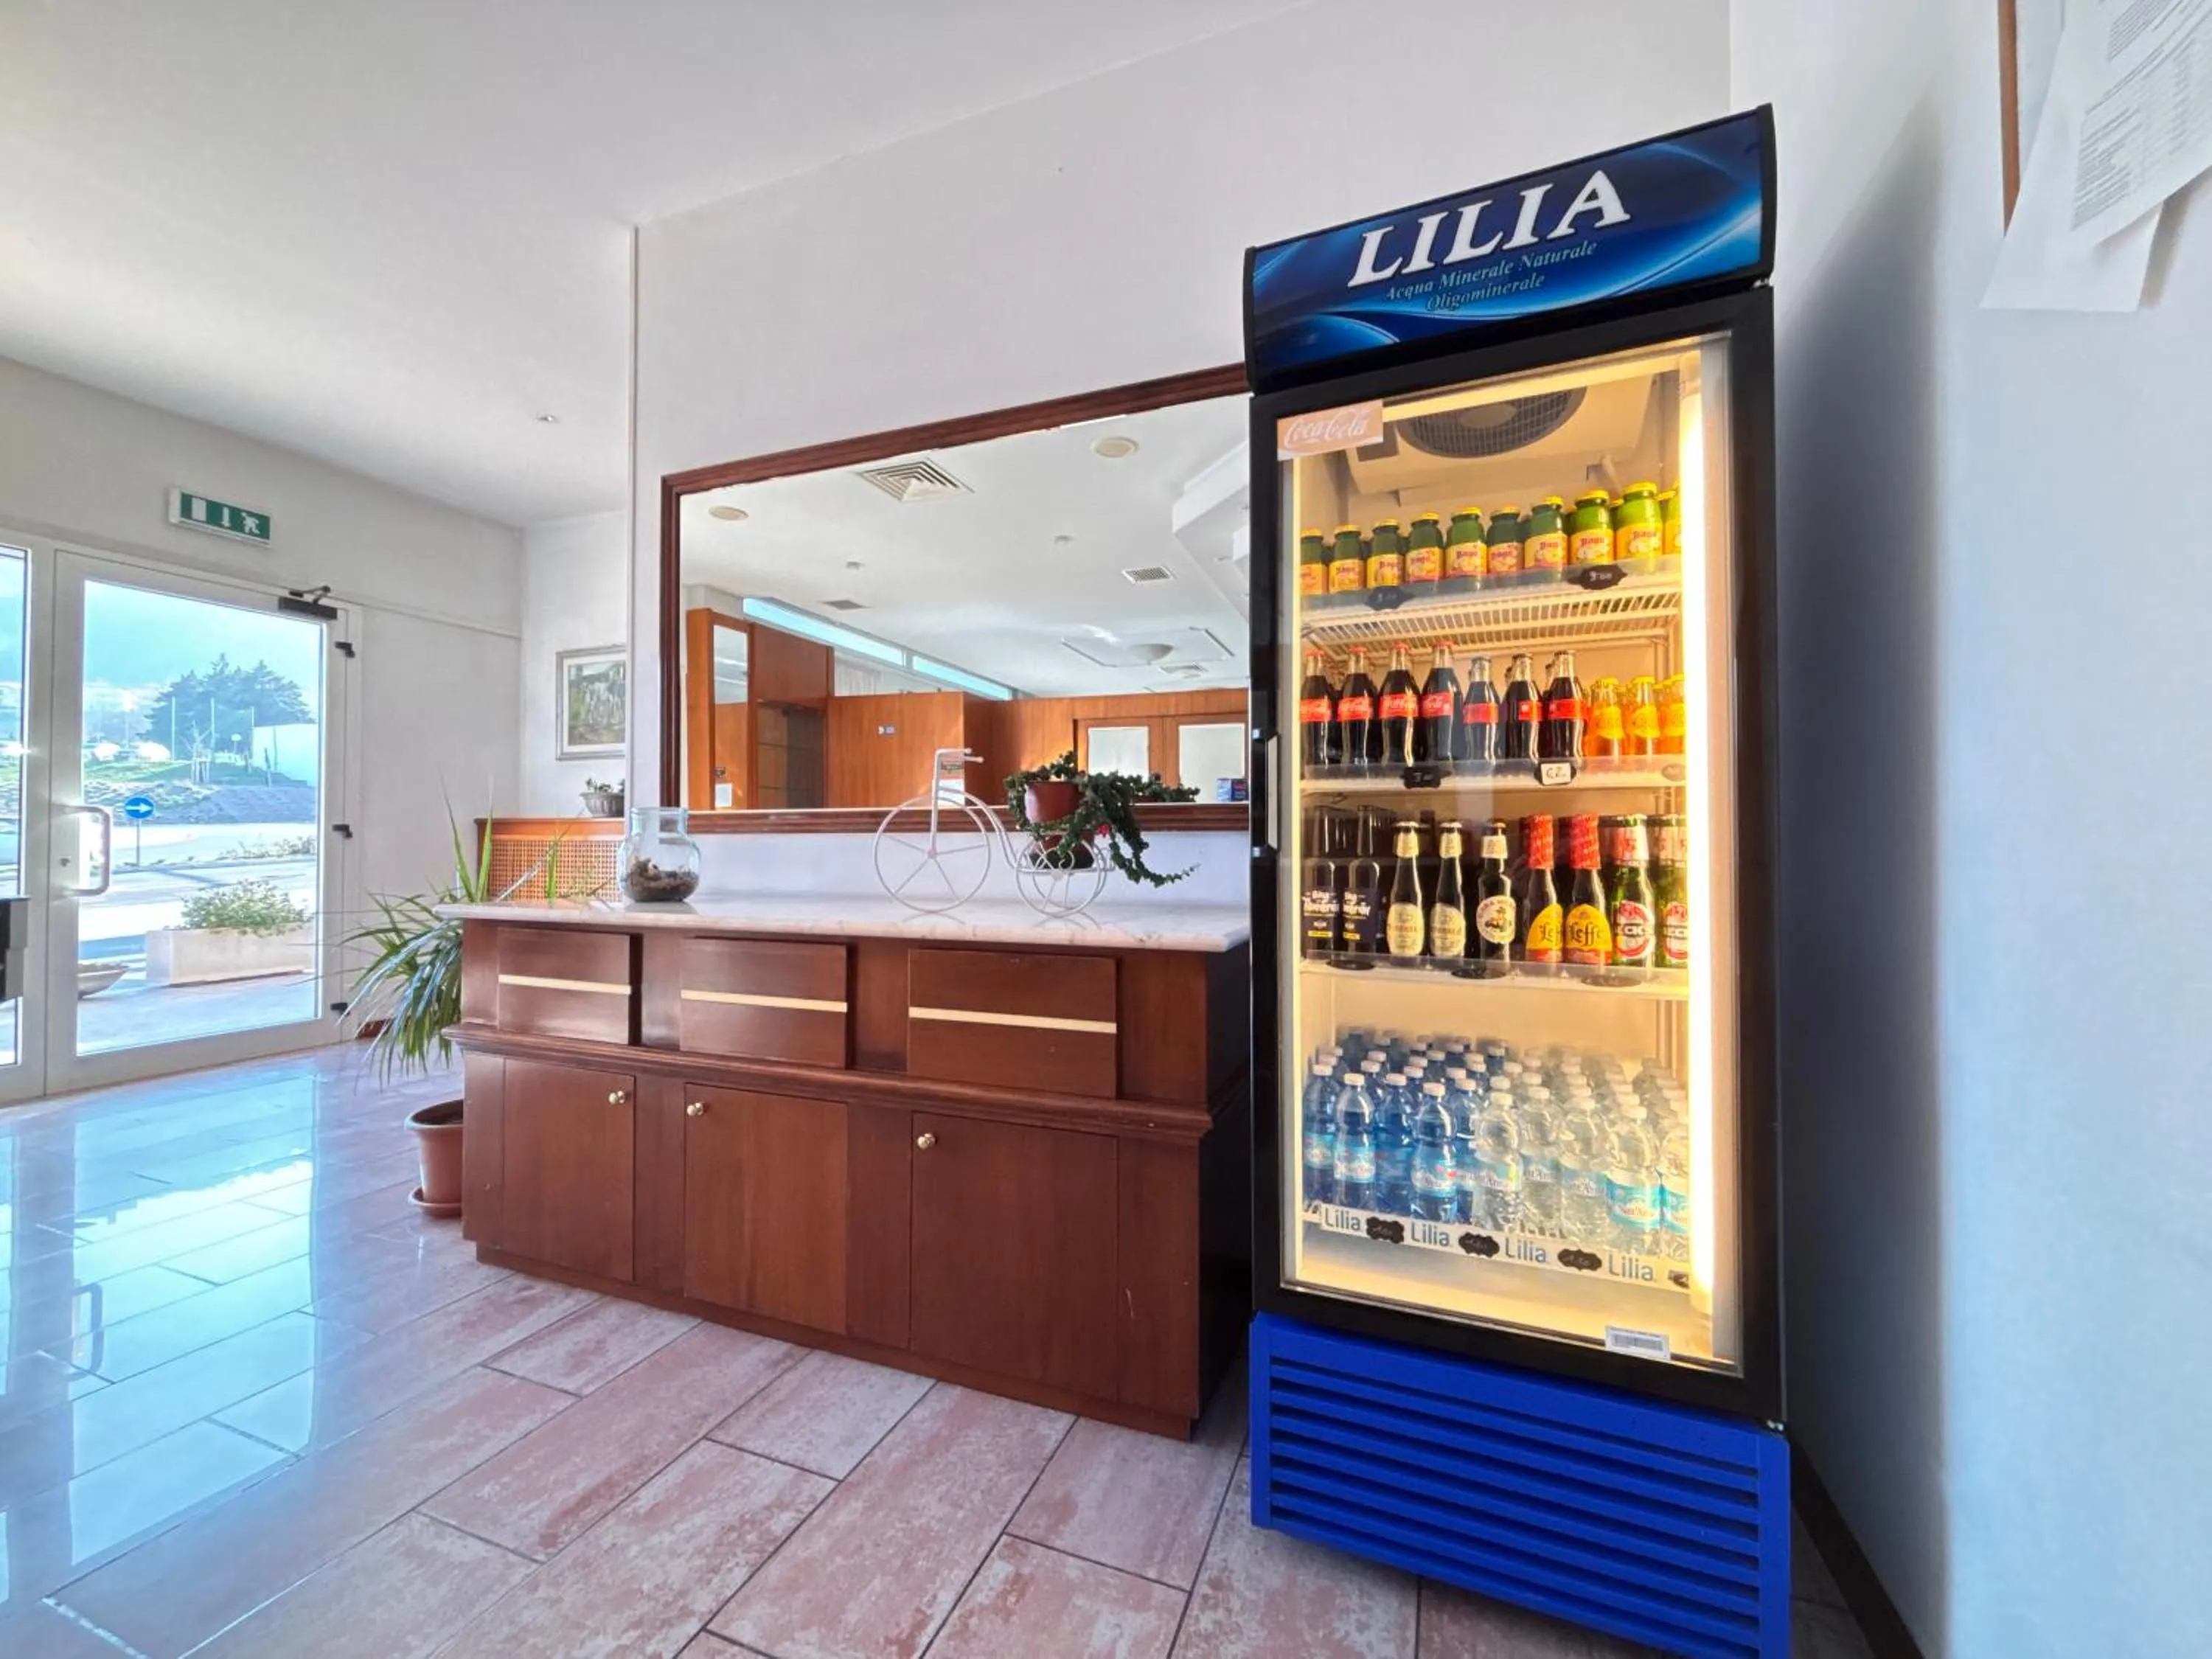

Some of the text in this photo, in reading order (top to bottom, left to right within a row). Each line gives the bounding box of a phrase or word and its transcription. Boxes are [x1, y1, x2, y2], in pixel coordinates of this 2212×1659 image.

[1348, 170, 1630, 287] LILIA
[1386, 240, 1597, 300] Acqua Minerale Naturale
[1427, 273, 1545, 311] Oligominerale
[1325, 1208, 1361, 1231] Lilia
[1411, 1222, 1450, 1247] Lilia
[1506, 1237, 1546, 1263] Lilia
[1608, 1251, 1653, 1281] Lilia
